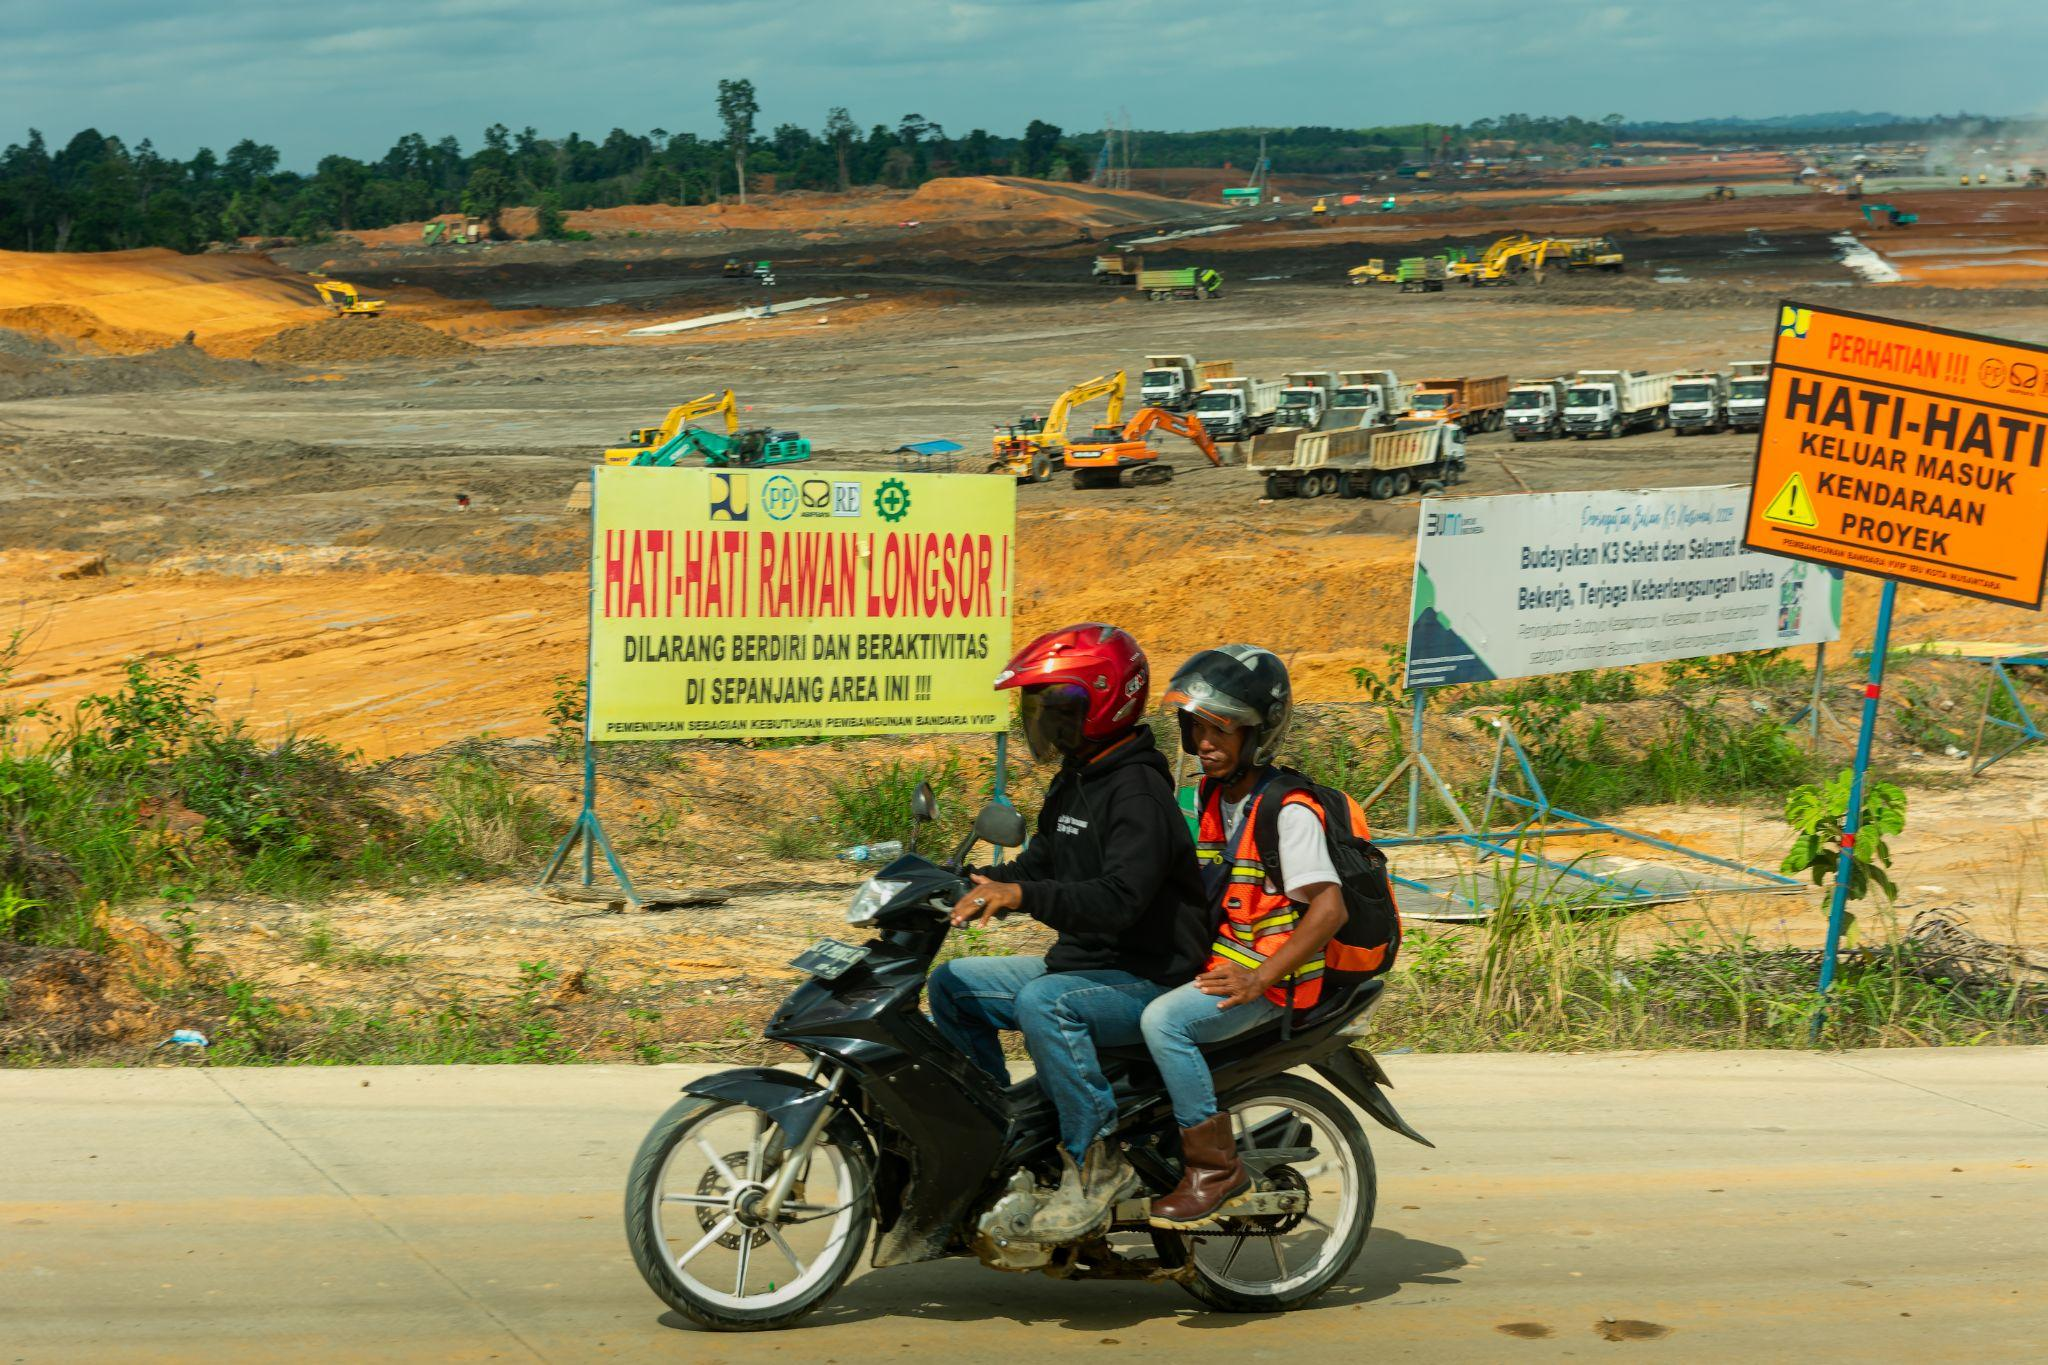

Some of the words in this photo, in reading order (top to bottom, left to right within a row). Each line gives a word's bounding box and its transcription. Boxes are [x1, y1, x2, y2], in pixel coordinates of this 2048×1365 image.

[1827, 332, 1941, 379] PERHATIAN
[1944, 352, 1970, 385] !!!
[1785, 377, 2048, 468] HATI-HATI
[1800, 431, 1907, 474] KELUAR
[1915, 454, 2016, 495] MASUK
[769, 487, 794, 510] PP
[835, 486, 859, 512] RE
[1817, 471, 1986, 526] KENDARAAN
[1520, 543, 1598, 572] Budayakan
[1601, 541, 1620, 564] K3
[1622, 540, 1659, 563] Sehat
[1661, 540, 1685, 561] dan
[1688, 536, 1736, 559] Selamat
[1841, 513, 1950, 555] PROYEK
[604, 530, 748, 618] HATI-HATI
[759, 531, 858, 618] RAWAN
[866, 532, 992, 618] LONGSOR
[1000, 534, 1009, 618] !
[1518, 582, 1574, 612] Bekerja,
[1578, 580, 1628, 609] Terjaga
[1631, 576, 1737, 602] Keberlangsungan
[1740, 568, 1775, 592] Usaha
[624, 634, 726, 662] DILARANG
[732, 634, 807, 661] BERDIRI
[813, 633, 851, 660] DAN
[856, 633, 989, 660] BERAKTIVITAS
[686, 677, 706, 705] DI
[711, 676, 824, 704] SEPANJANG
[829, 675, 879, 702] AREA
[884, 675, 911, 701] INI
[607, 721, 684, 733] PEMENUHAN
[687, 720, 747, 731] SEBAGIAN
[750, 718, 822, 730] KEBUTUHAN
[825, 717, 912, 728] PEMBANGUNAN
[915, 715, 968, 726] BANDARA
